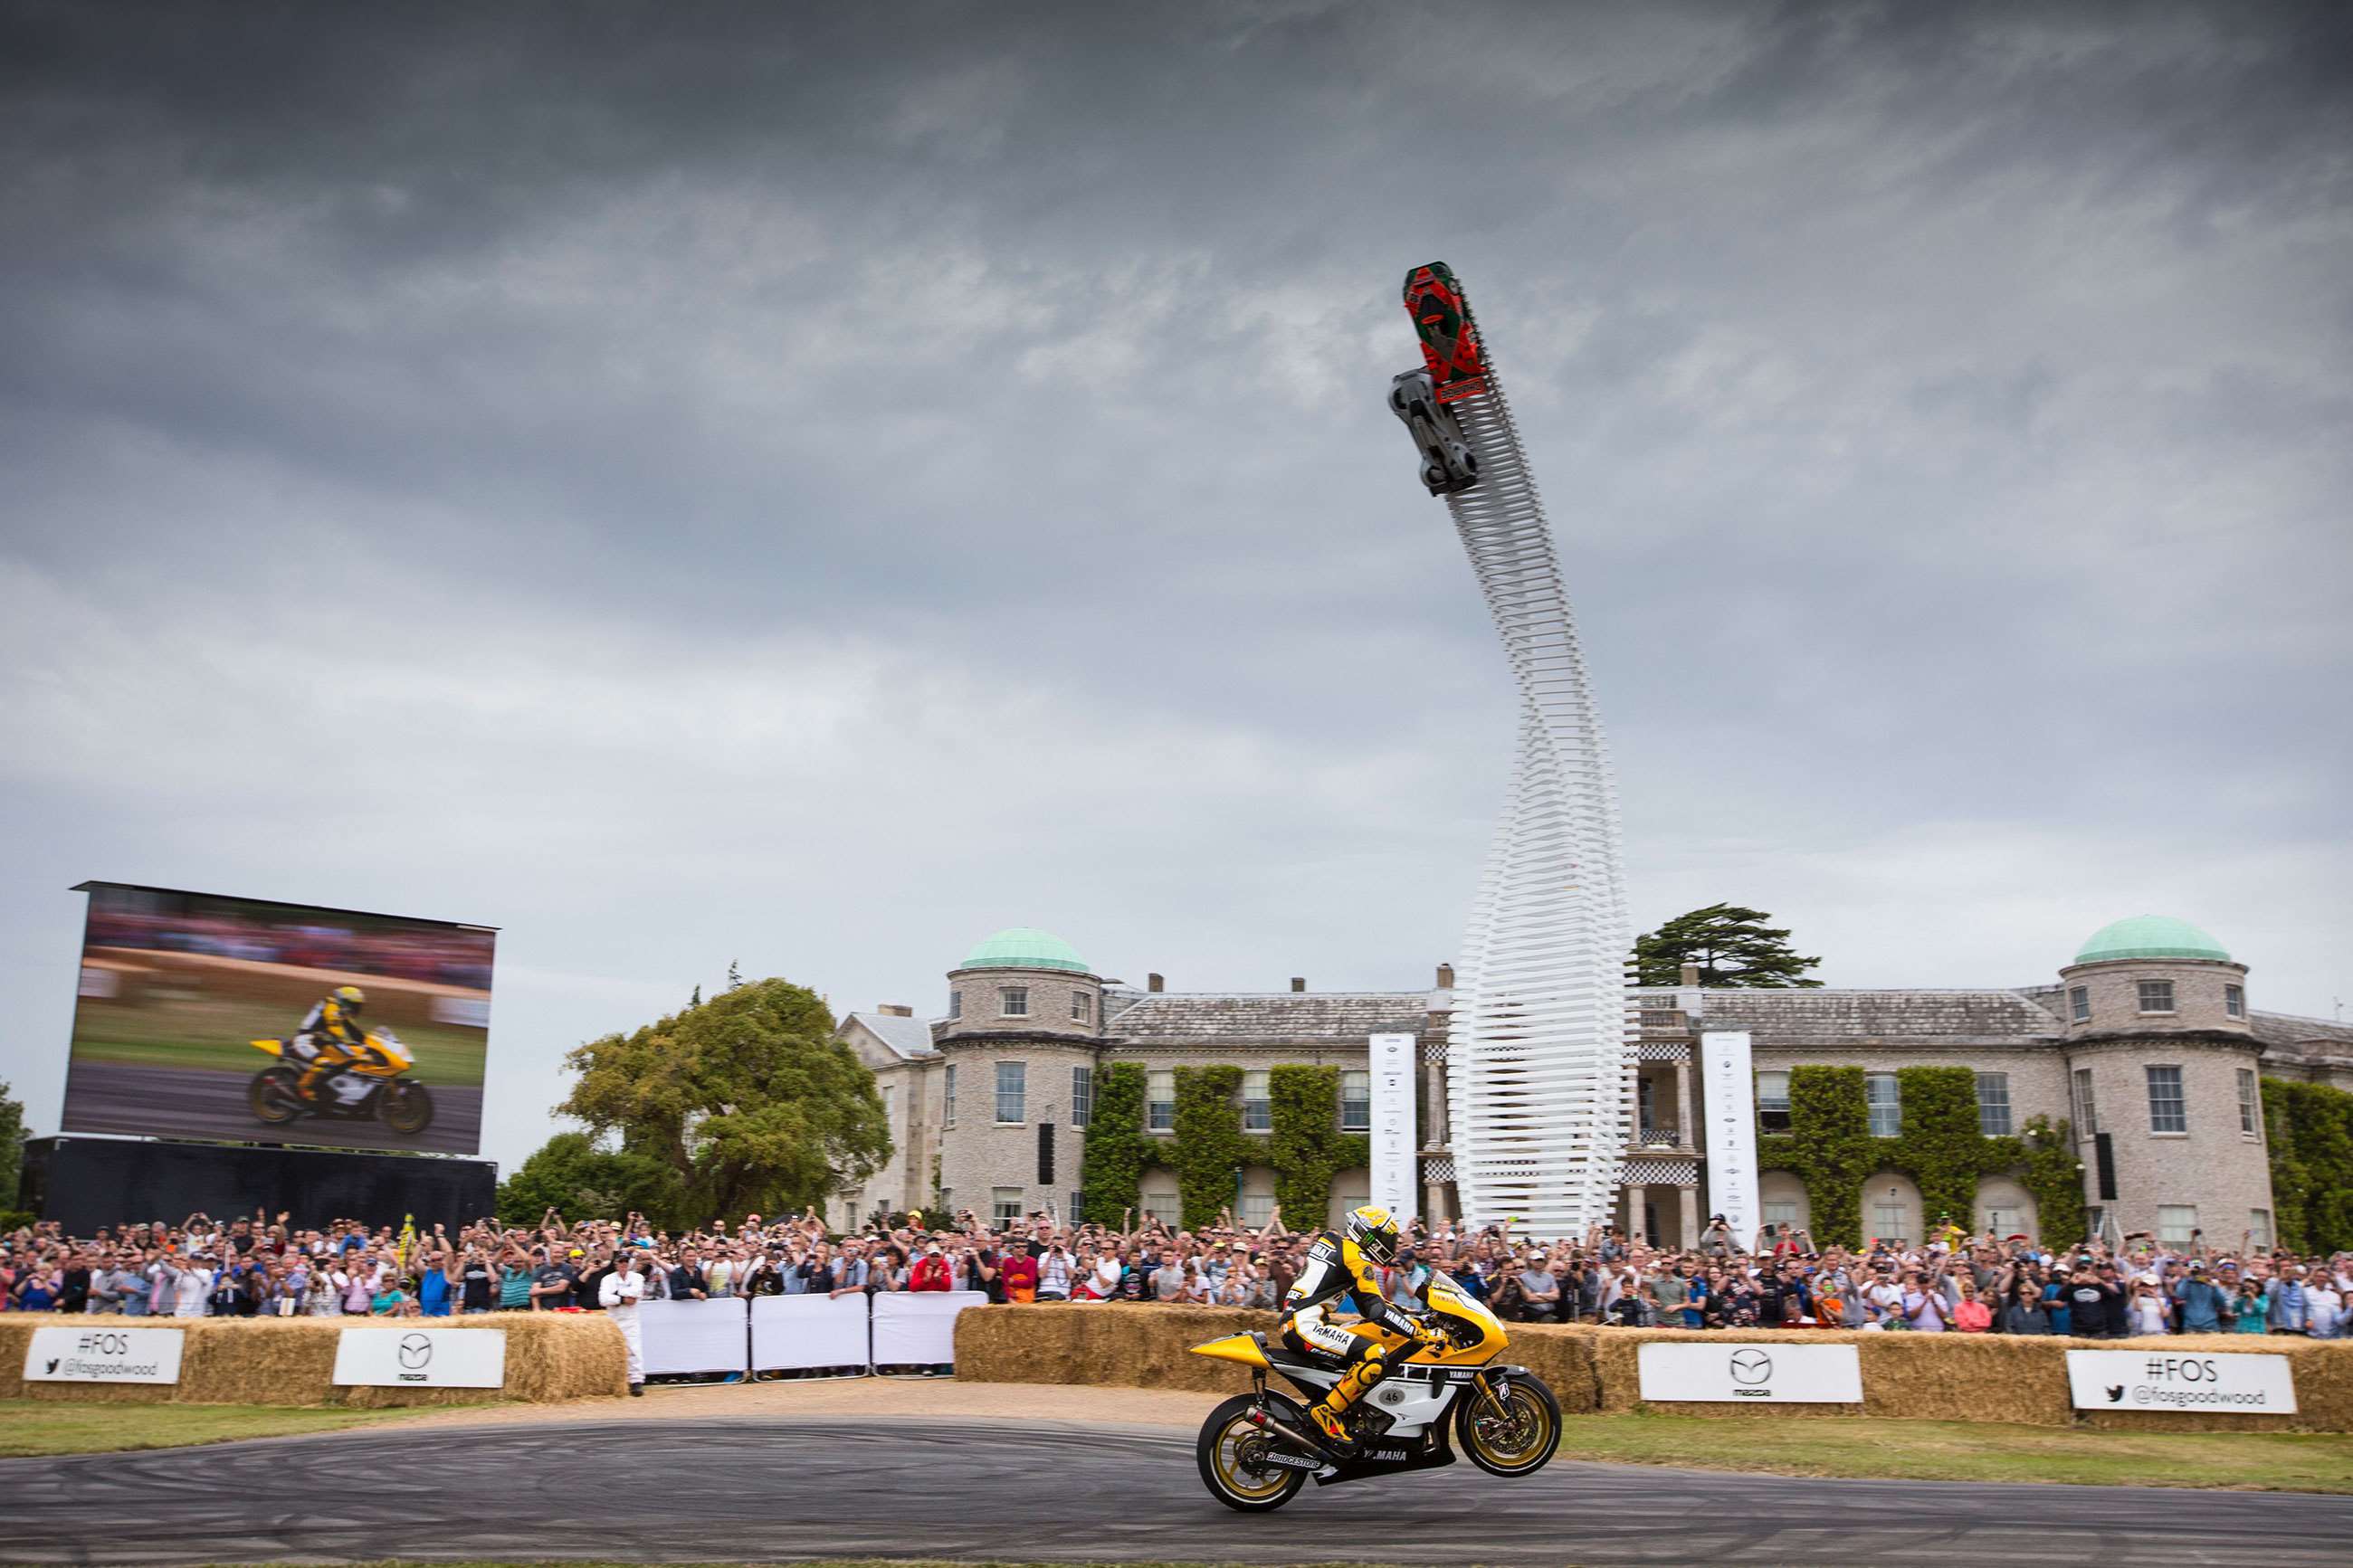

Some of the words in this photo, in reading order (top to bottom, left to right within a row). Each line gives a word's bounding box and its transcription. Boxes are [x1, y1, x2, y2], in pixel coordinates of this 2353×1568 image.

[1384, 1309, 1415, 1335] YAMAHA
[78, 1334, 129, 1355] #FOS
[1312, 1324, 1350, 1345] YAMAHA
[64, 1358, 158, 1378] @fosgoodwood
[1449, 1371, 1474, 1379] YAMAHA
[2146, 1358, 2217, 1383] #FOS
[1386, 1392, 1398, 1402] 46
[2132, 1385, 2266, 1407] @fosgoodwood
[1266, 1452, 1321, 1468] BRIDGESTONE
